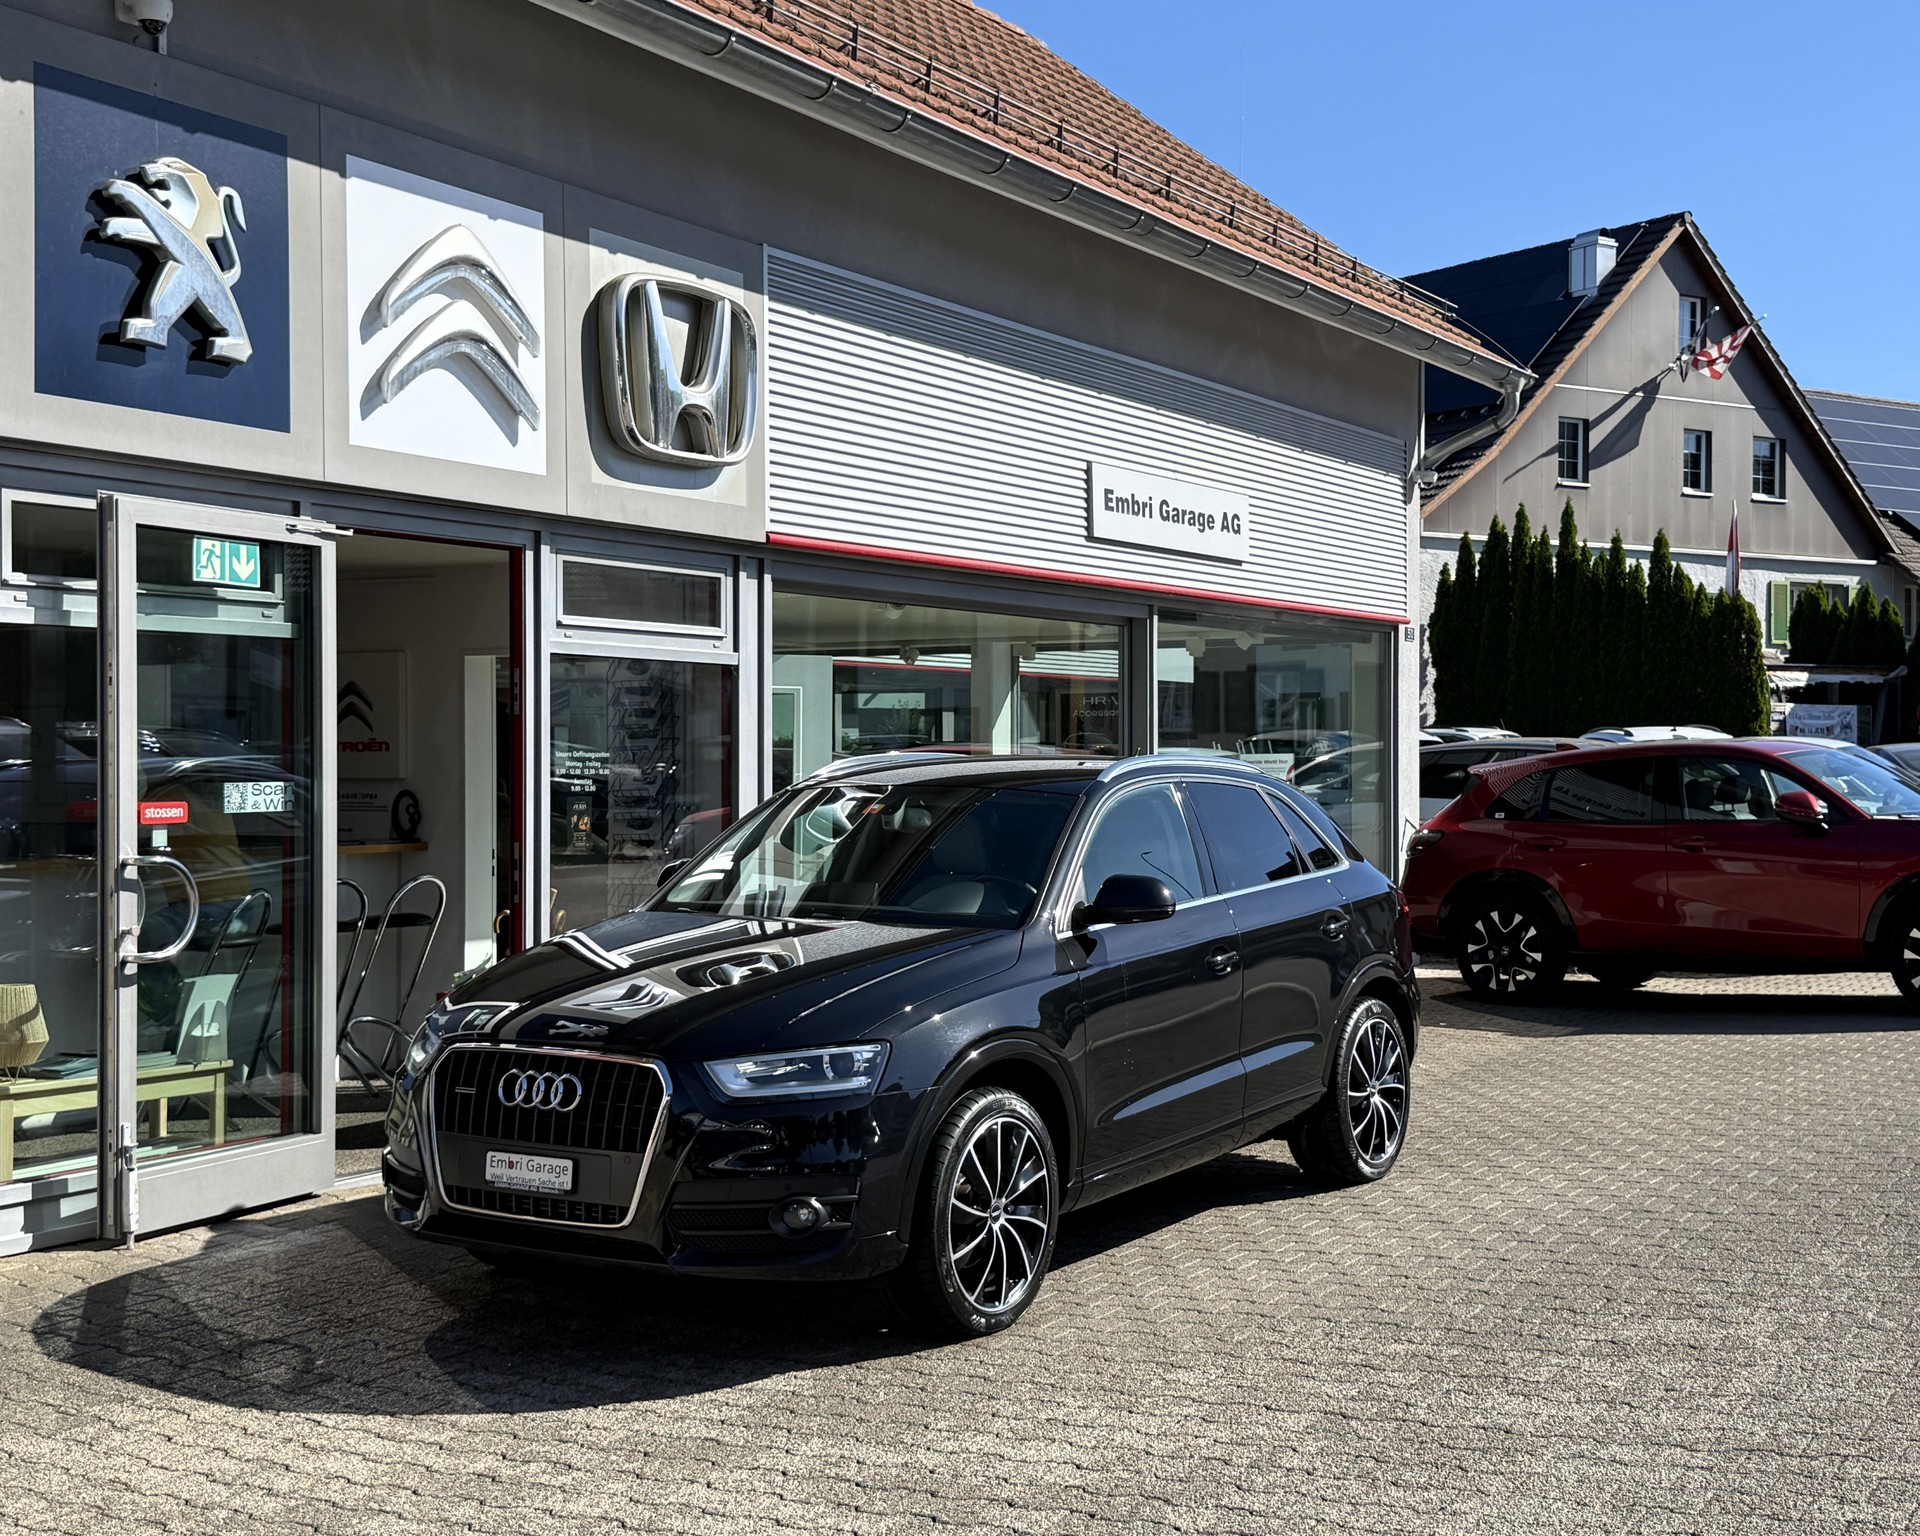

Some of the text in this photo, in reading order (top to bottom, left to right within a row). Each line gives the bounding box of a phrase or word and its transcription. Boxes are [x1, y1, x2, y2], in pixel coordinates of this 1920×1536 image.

[1104, 488, 1241, 535] Embri Garage AG
[565, 760, 583, 768] Montag
[586, 760, 601, 768] Freitag
[251, 783, 295, 796] Scan
[251, 796, 295, 810] & Win
[144, 806, 184, 818] stossen
[490, 1155, 569, 1179] Embri Garage
[491, 1172, 504, 1180] Weil
[506, 1174, 537, 1185] Vertrauen
[538, 1177, 557, 1187] Sache
